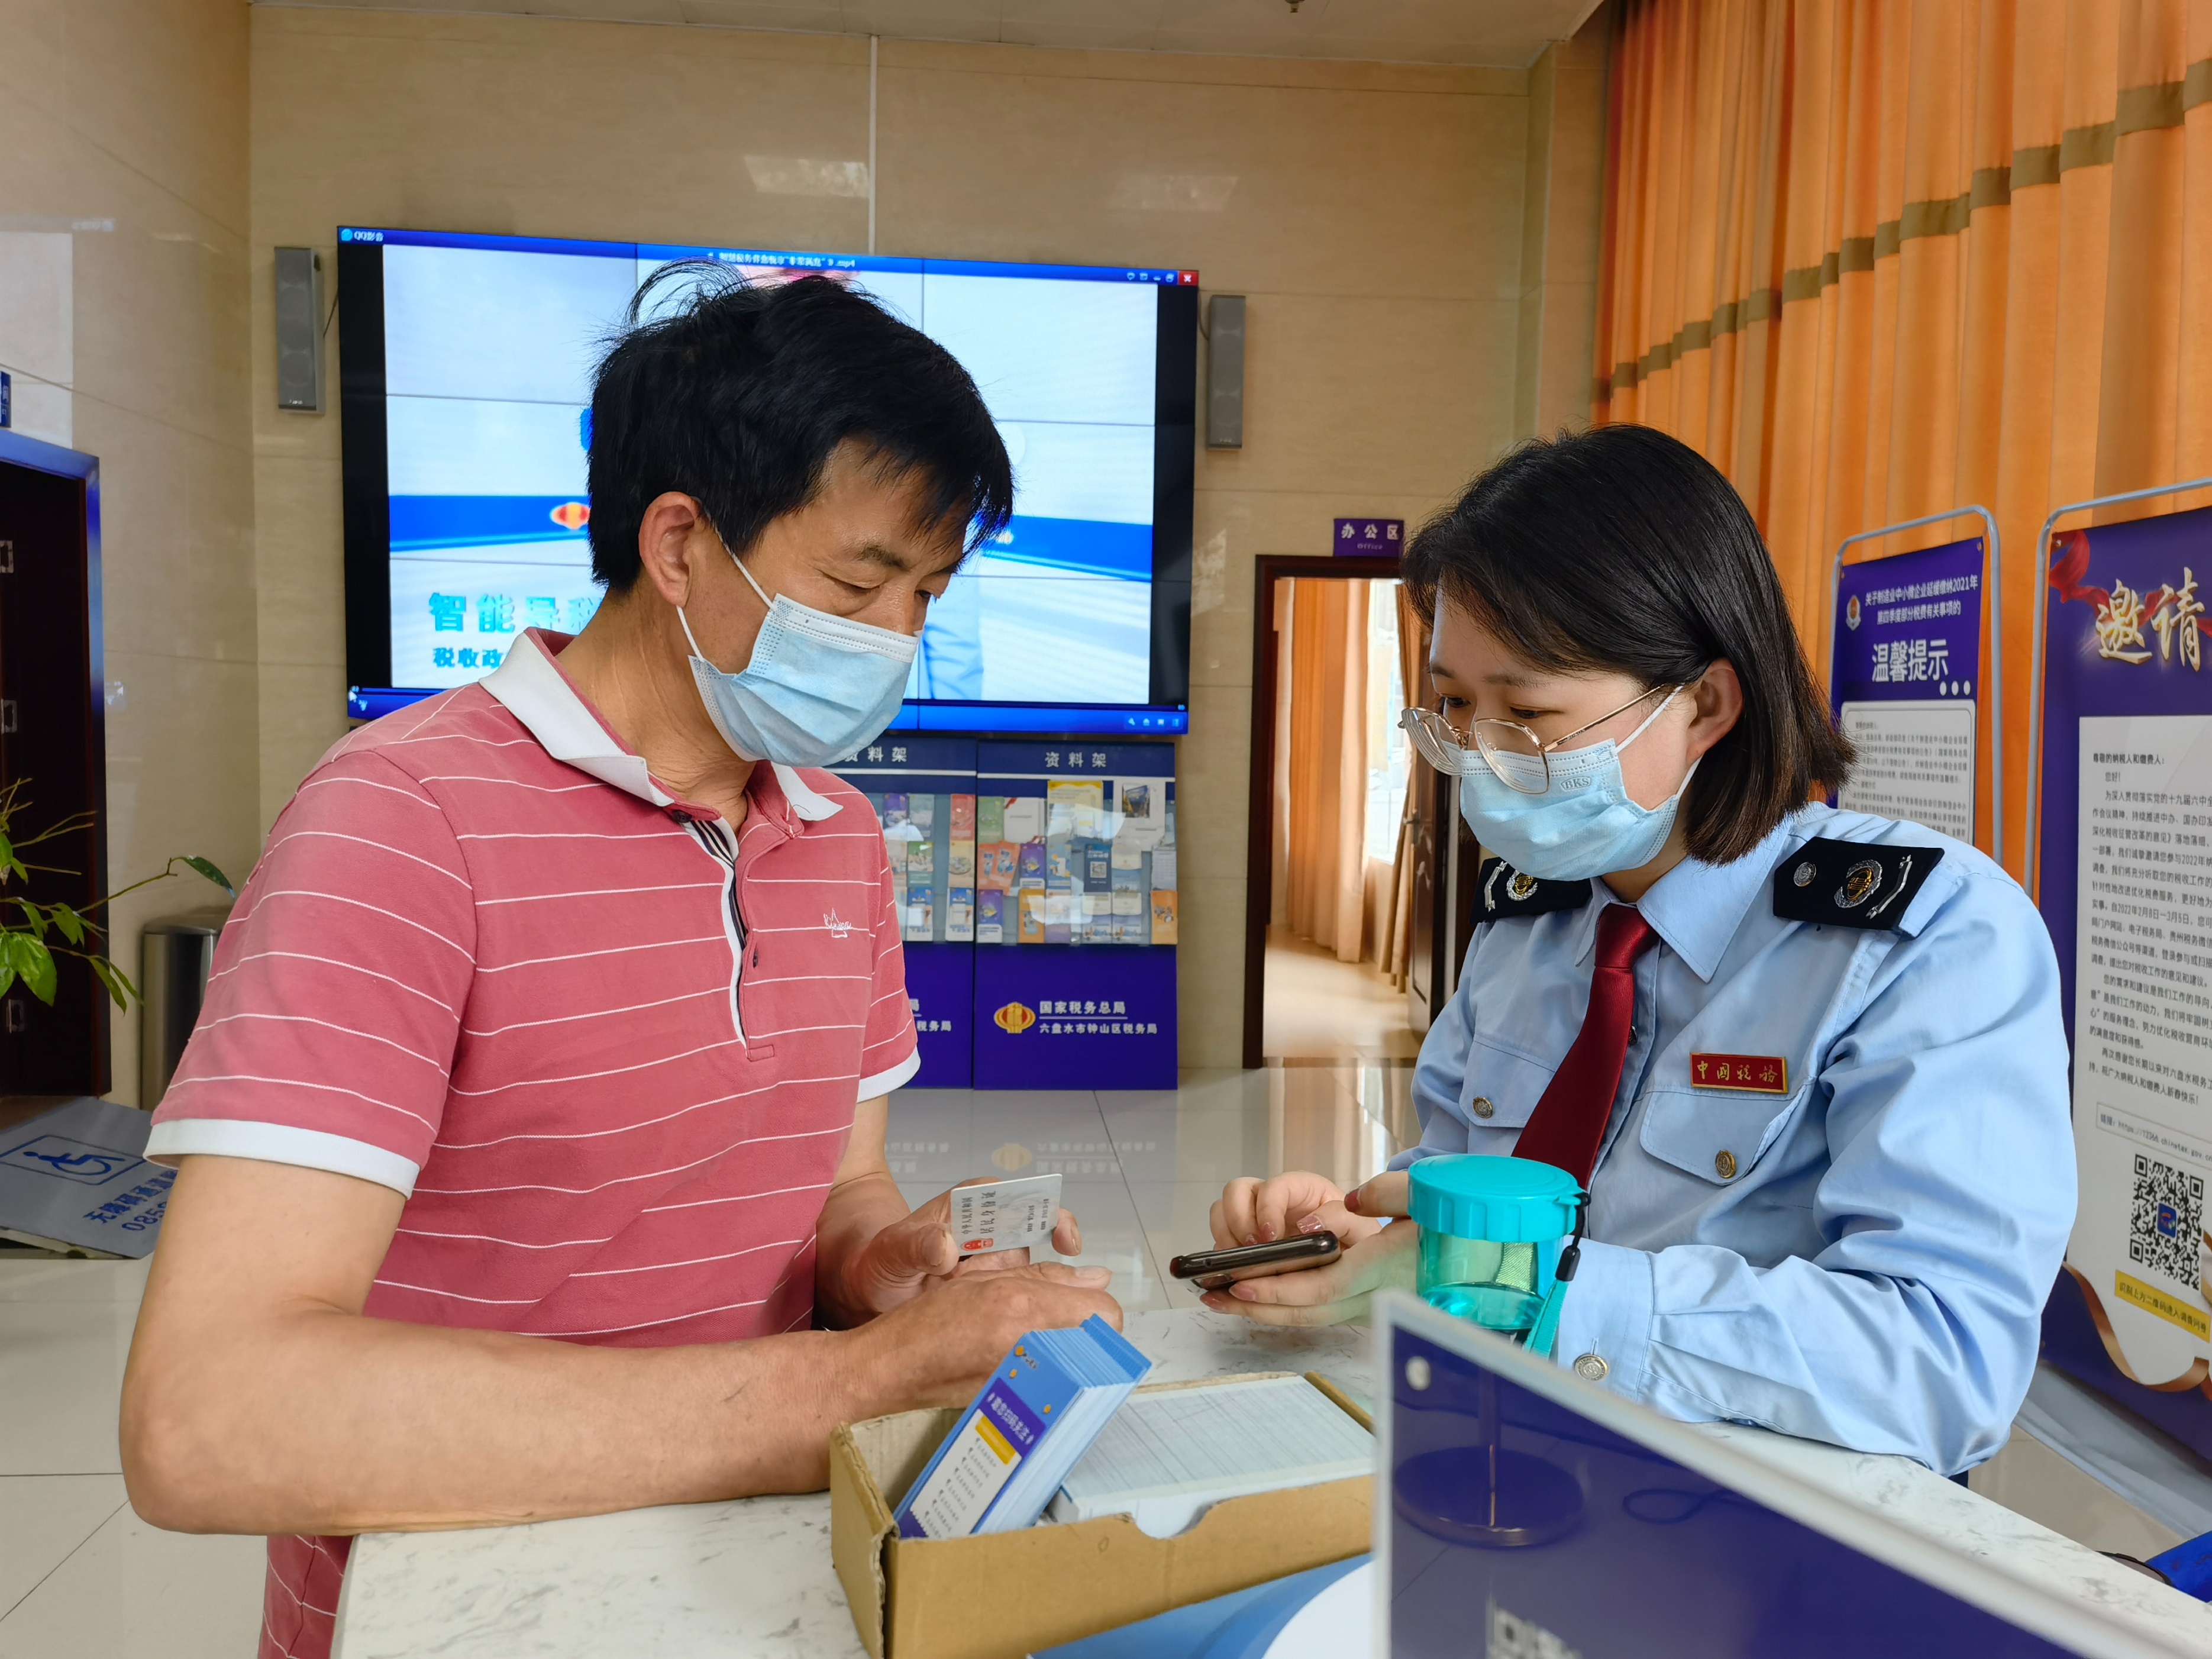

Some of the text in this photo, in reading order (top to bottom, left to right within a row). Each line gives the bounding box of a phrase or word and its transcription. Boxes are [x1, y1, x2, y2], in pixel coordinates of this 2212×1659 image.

[1341, 522, 1399, 540] 办公区
[2095, 567, 2205, 672] 邀请
[433, 647, 507, 669] 税收政
[1872, 638, 1949, 683] 温馨提示
[1045, 751, 1107, 768] 资料架
[1565, 777, 1589, 789] BKS
[1039, 1001, 1126, 1015] 国家税务总局
[917, 1021, 952, 1032] 税务局
[1039, 1023, 1157, 1034] 六盘水市钟山区税务局
